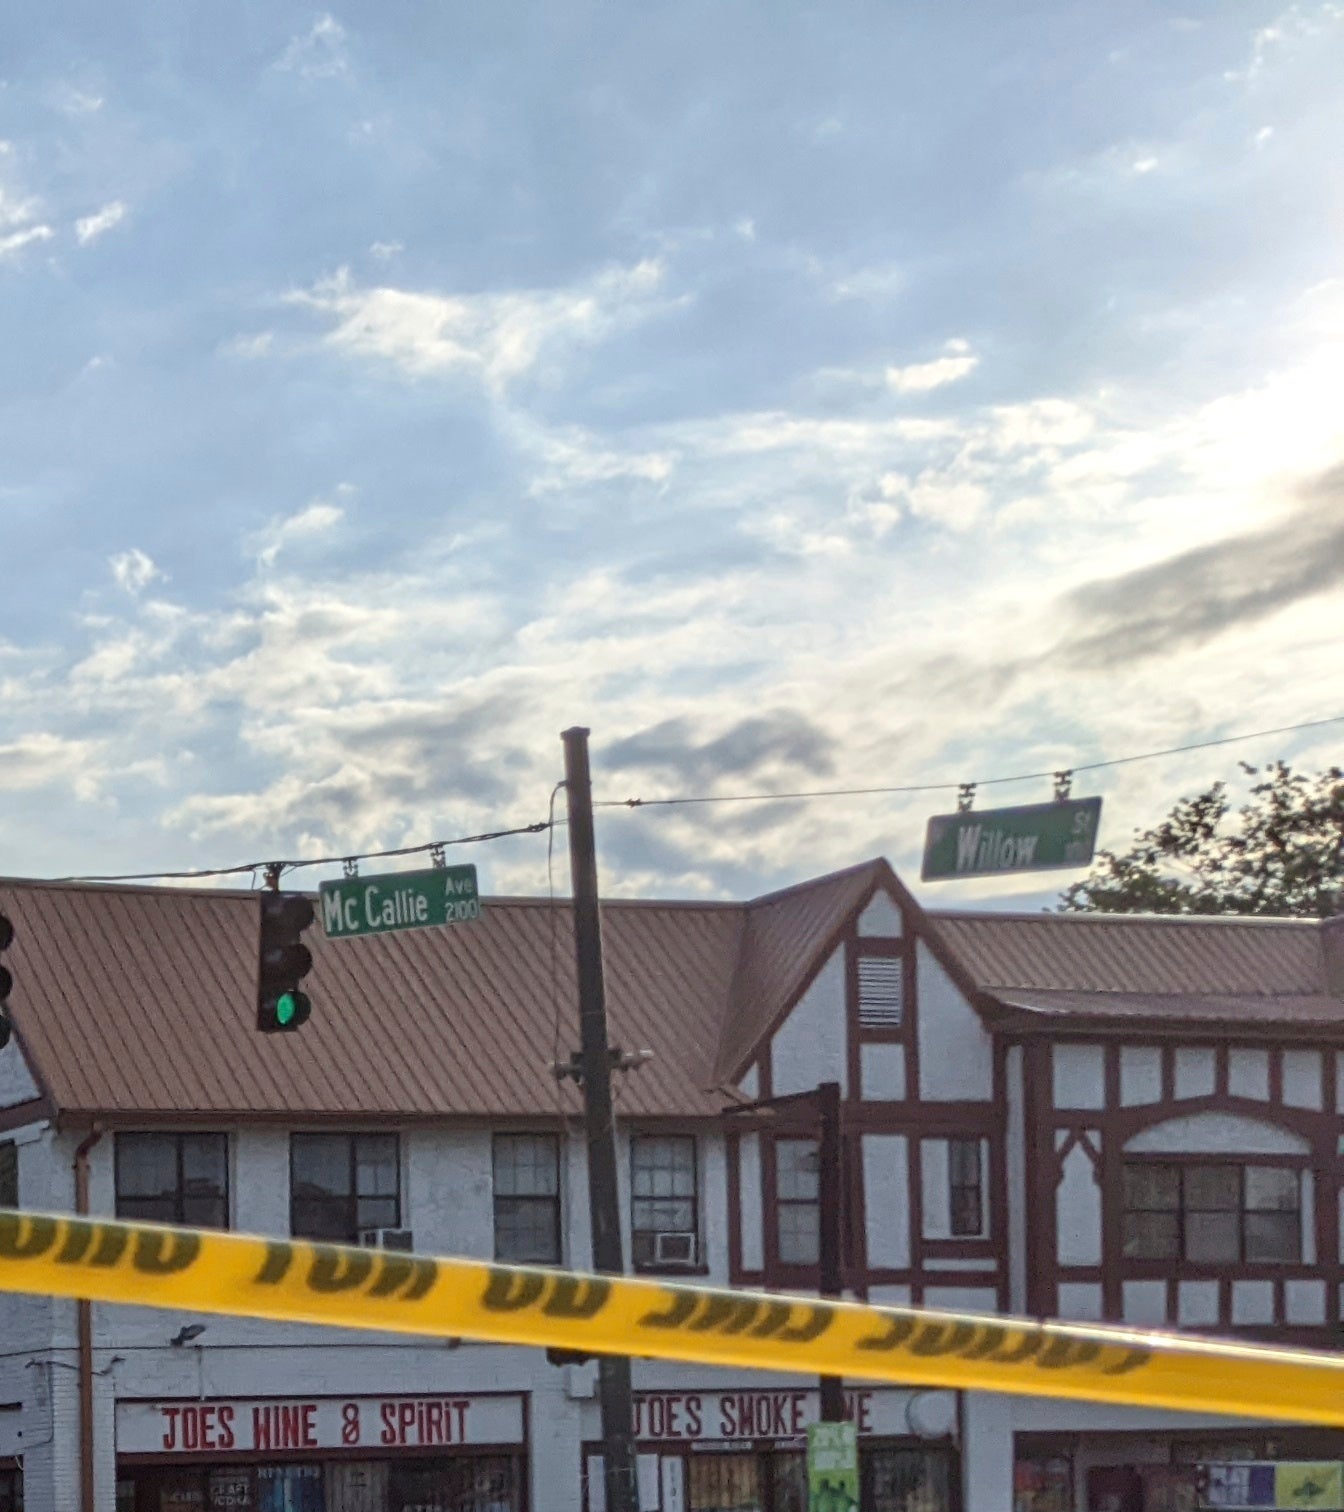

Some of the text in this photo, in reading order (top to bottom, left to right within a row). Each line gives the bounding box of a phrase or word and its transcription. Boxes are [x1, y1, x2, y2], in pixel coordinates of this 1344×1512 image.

[955, 823, 1039, 873] Willow
[444, 876, 474, 896] Ave
[444, 898, 480, 922] 2100
[162, 1406, 235, 1450] JOES
[252, 1405, 318, 1450] WINE
[341, 1403, 361, 1445] &
[632, 1395, 702, 1438] JOES
[720, 1393, 808, 1436] SMOKE
